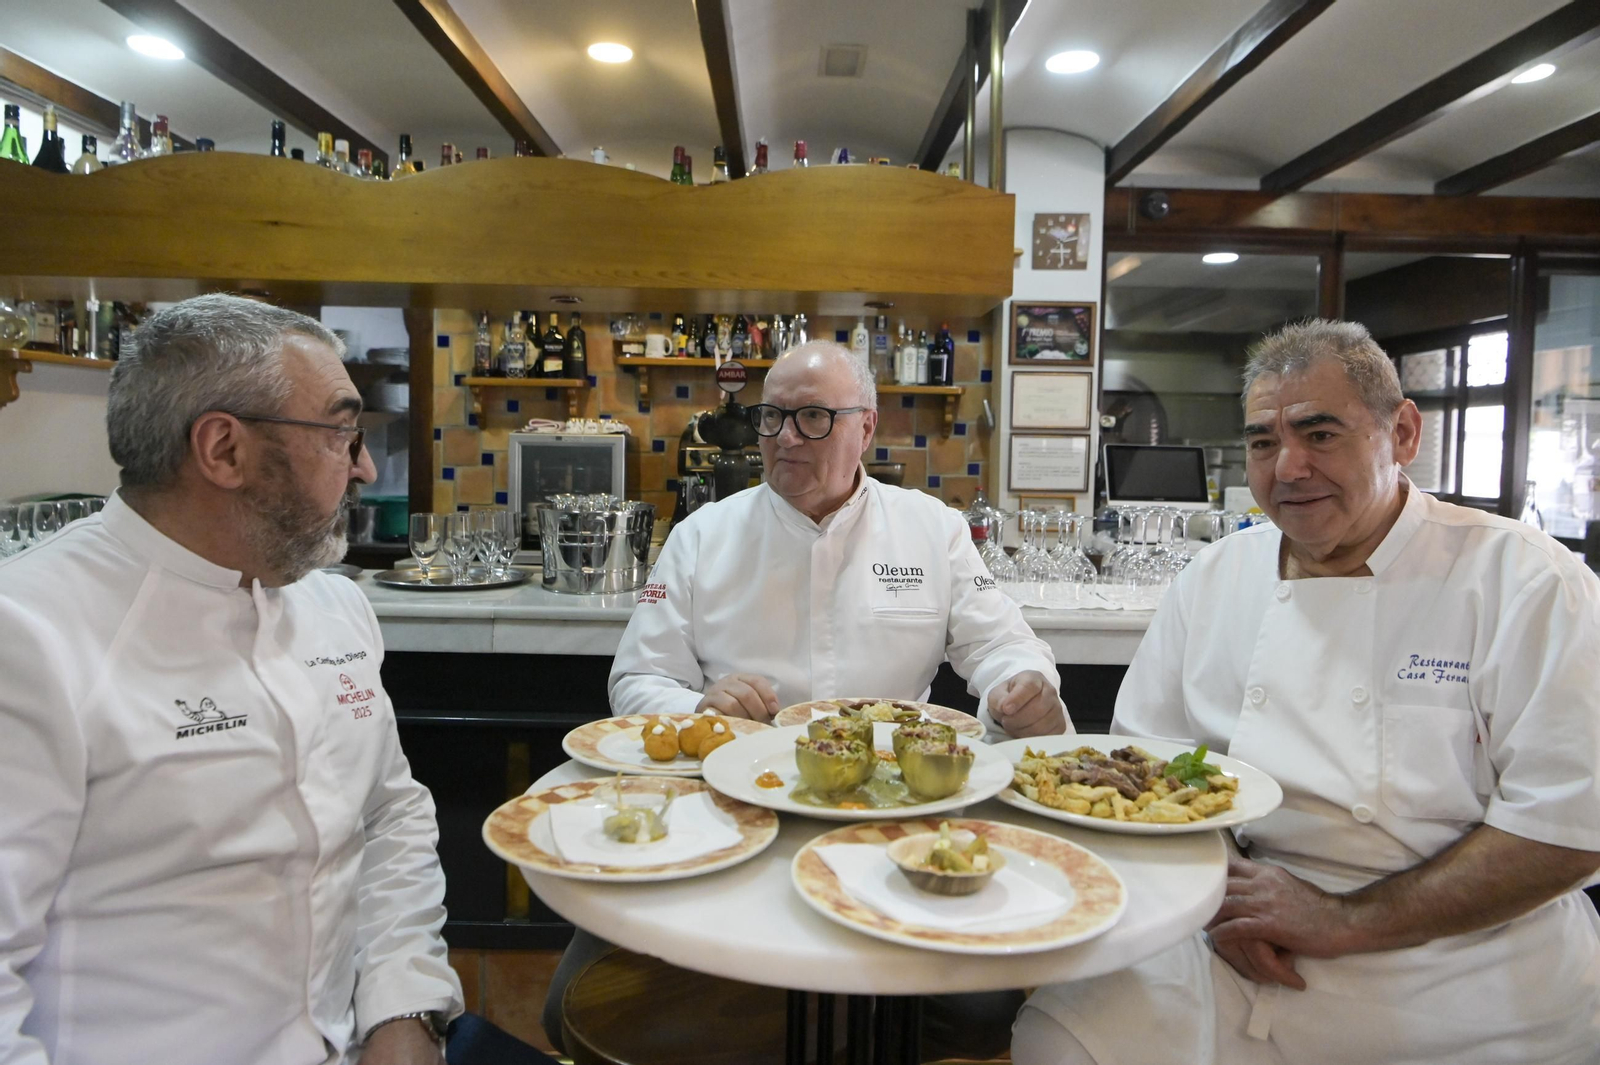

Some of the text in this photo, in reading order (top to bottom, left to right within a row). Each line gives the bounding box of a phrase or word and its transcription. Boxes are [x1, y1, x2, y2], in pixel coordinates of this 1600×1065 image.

[718, 370, 747, 379] AMBAR
[872, 563, 924, 576] Oleum
[304, 660, 317, 668] La
[336, 656, 347, 665] de
[345, 650, 367, 662] Diego
[1397, 668, 1426, 680] Casa
[336, 688, 375, 705] MICHELIN
[351, 705, 372, 719] 2025
[176, 719, 247, 740] MICHELIN
